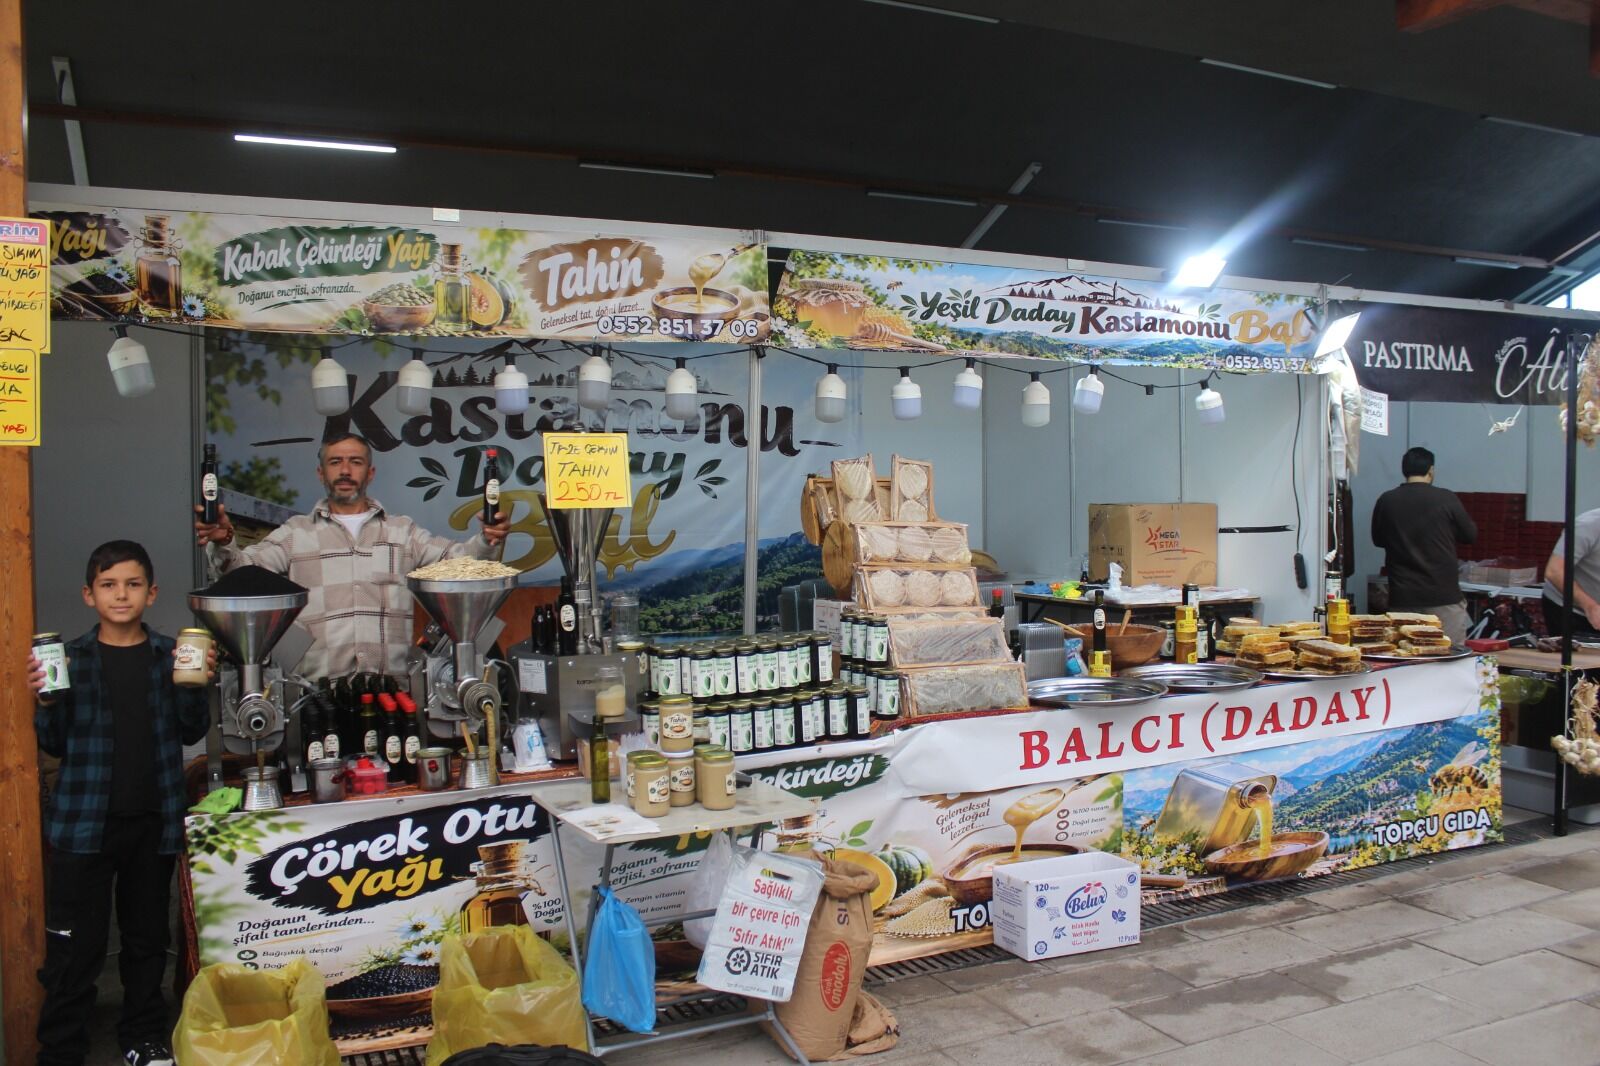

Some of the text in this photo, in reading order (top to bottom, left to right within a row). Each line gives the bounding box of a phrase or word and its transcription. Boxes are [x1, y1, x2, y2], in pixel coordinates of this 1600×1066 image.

[50, 219, 107, 260] Yağı
[224, 233, 431, 281] Kabak Çekirdeği Yağı
[539, 247, 644, 306] Tahin
[238, 282, 362, 305] Doğanın enerjisi, sofranızda...
[540, 311, 578, 330] Geleneksel
[597, 316, 758, 337] 0552 851 37 06
[919, 291, 1313, 353] Yeşil Daday Kastamonu Bal
[1364, 340, 1475, 373] PASTIRMA
[555, 481, 624, 501] 250 TL
[1159, 531, 1180, 539] MEGA
[1159, 541, 1179, 549] STAR
[1019, 677, 1393, 771] BALCI (DADAY)
[935, 798, 991, 826] Geleneksel
[940, 808, 991, 836] tat, doğal
[950, 822, 985, 841] lezzet...
[1374, 806, 1493, 846] TOPÇU GIDA
[269, 803, 538, 896] Çörek Otu
[327, 854, 444, 909] Yağı
[753, 878, 793, 901] Sağlıklı
[1035, 883, 1050, 892] 120
[625, 889, 686, 904] Zengin vitamin
[1068, 894, 1106, 914] Belux
[534, 904, 564, 919] Doğal
[650, 903, 682, 912] koruma
[731, 901, 800, 929] bir çevre için
[233, 916, 375, 946] şifalı tanelerinden...
[237, 914, 306, 932] Doğanın
[1118, 935, 1124, 943] 12
[309, 945, 344, 955] desteği
[753, 951, 783, 966] SIFIR
[750, 964, 780, 980] ATIK
